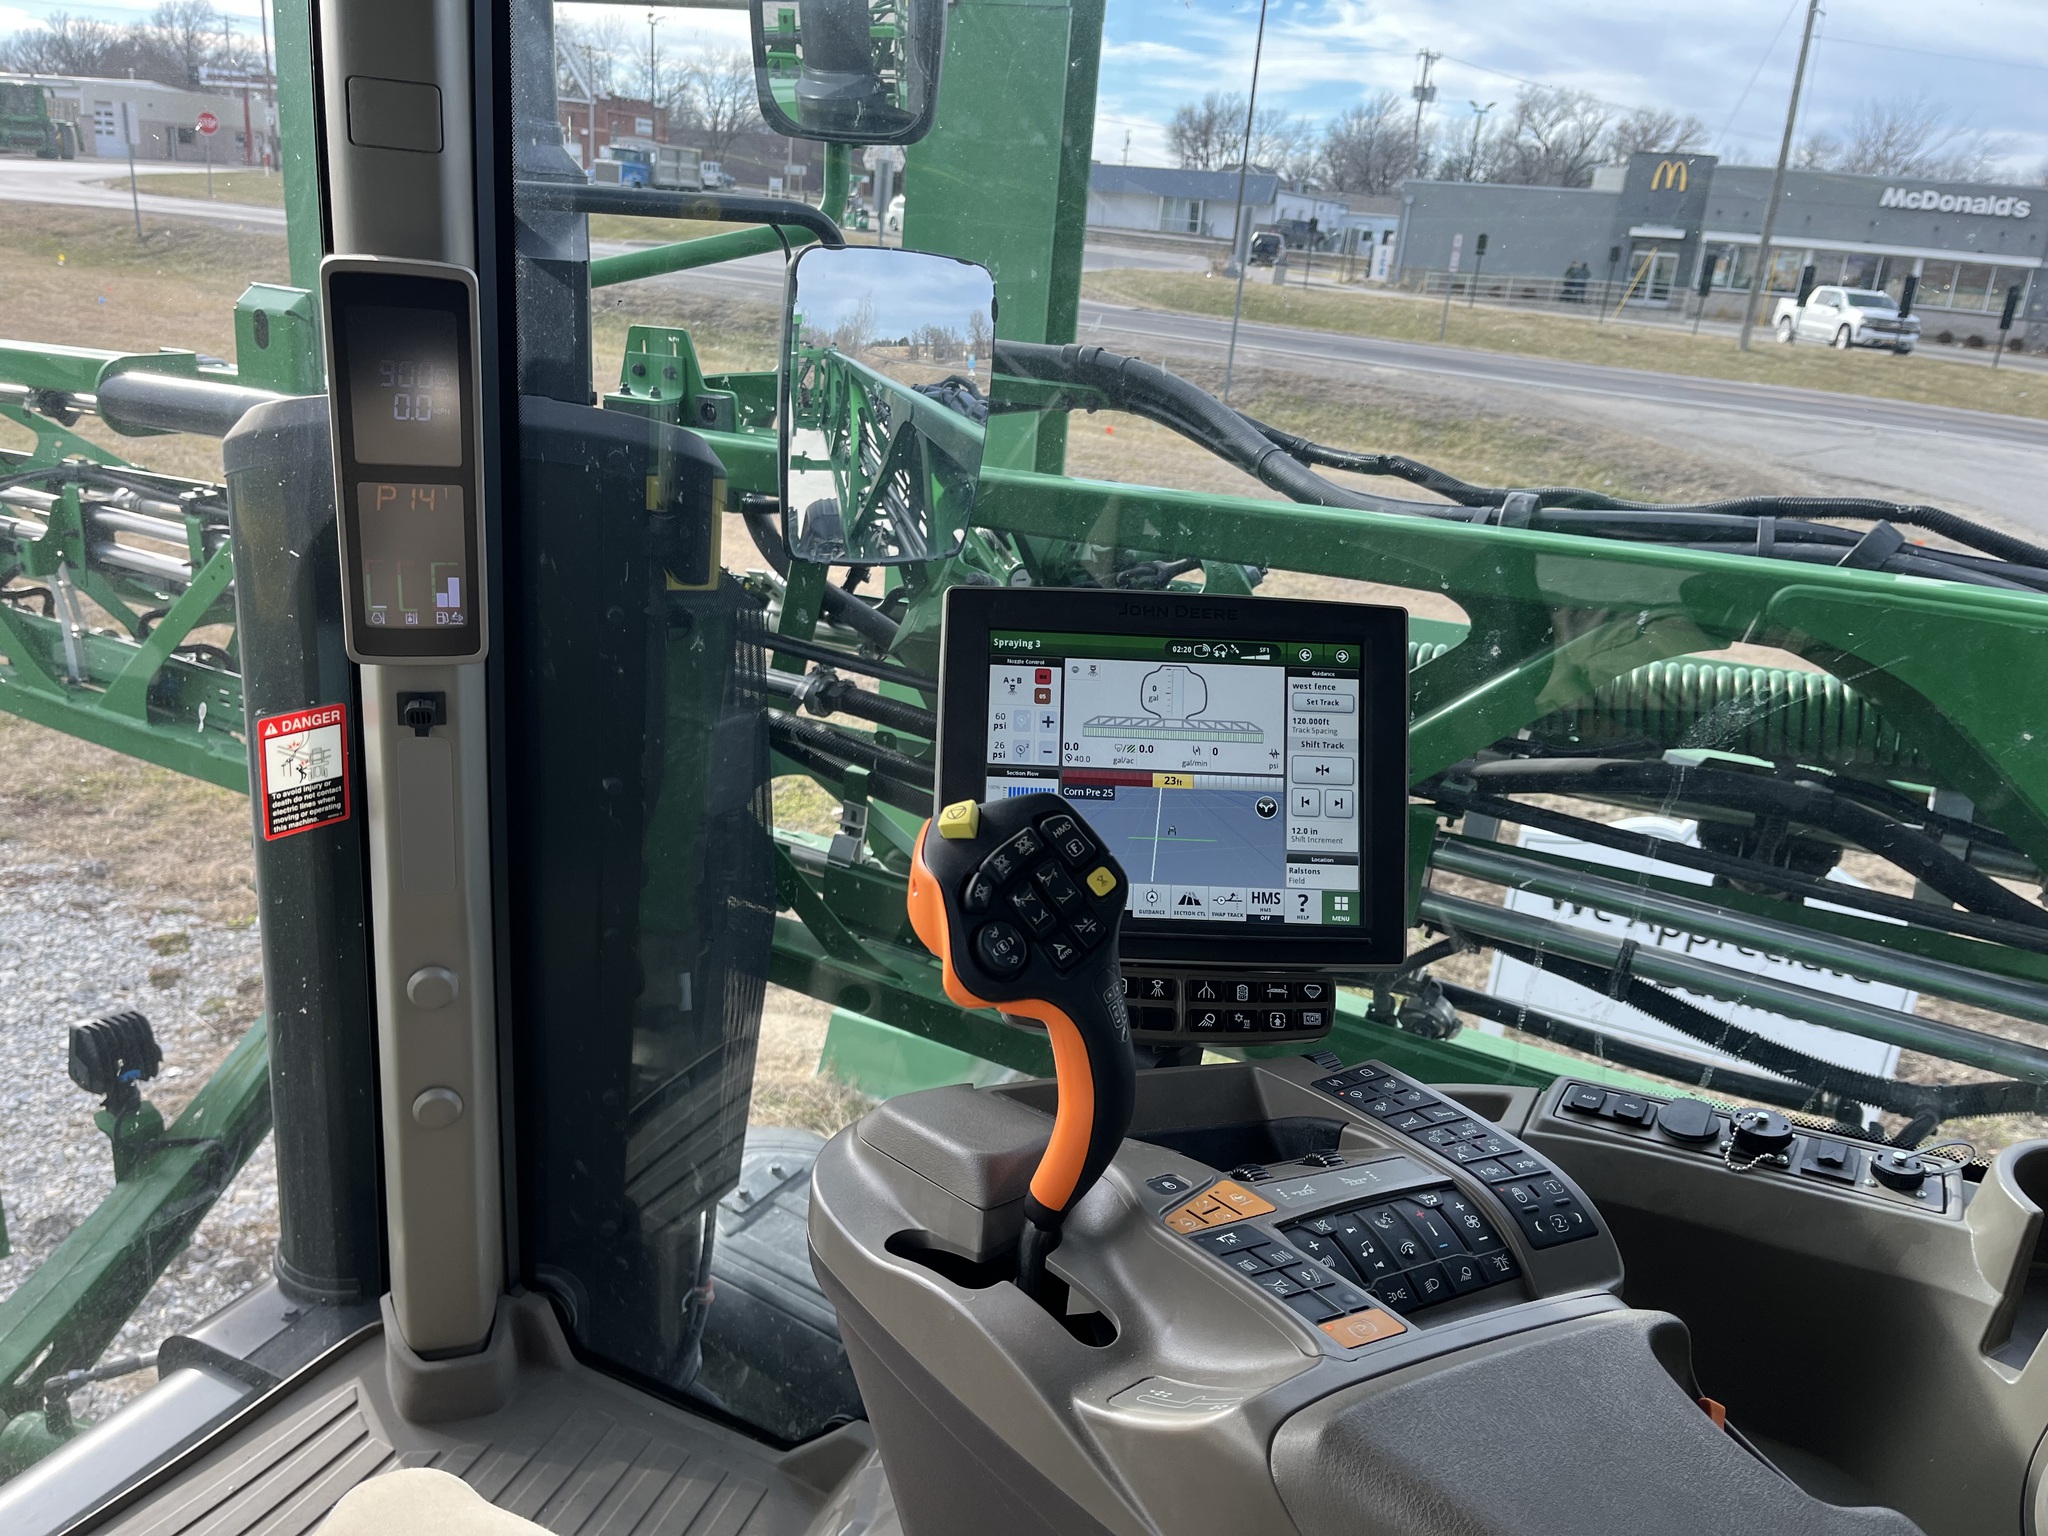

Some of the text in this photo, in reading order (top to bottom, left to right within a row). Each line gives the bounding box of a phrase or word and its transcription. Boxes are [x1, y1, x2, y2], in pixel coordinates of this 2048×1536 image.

[1879, 187, 2031, 218] McDonald's
[394, 393, 432, 421] 0.0
[377, 485, 397, 512] P
[1119, 602, 1238, 620] JOHN DEERE
[994, 638, 1041, 649] Spraying 3
[1148, 695, 1158, 703] gal
[282, 710, 340, 733] DANGER
[994, 722, 1006, 731] psi
[1312, 728, 1338, 736] Spacing
[1064, 742, 1079, 751] 0.0
[1139, 744, 1154, 754] 0.0
[992, 752, 1006, 760] psi
[1212, 748, 1218, 756] 0
[1113, 756, 1134, 766] gal/ac
[1182, 760, 1208, 768] gal/min
[282, 786, 302, 798] avoid
[303, 782, 322, 793] injury
[1064, 787, 1114, 797] Corn Pre 25
[272, 786, 342, 808] death do not contact
[272, 796, 336, 817] electric lines when
[273, 813, 300, 825] moving
[310, 802, 342, 816] operating
[273, 825, 288, 834] this
[1052, 822, 1072, 838] HMS
[1308, 836, 1343, 844] Increment
[1288, 867, 1320, 875] Ralstons
[1252, 892, 1281, 904] HMS
[1060, 948, 1072, 960] AUTO
